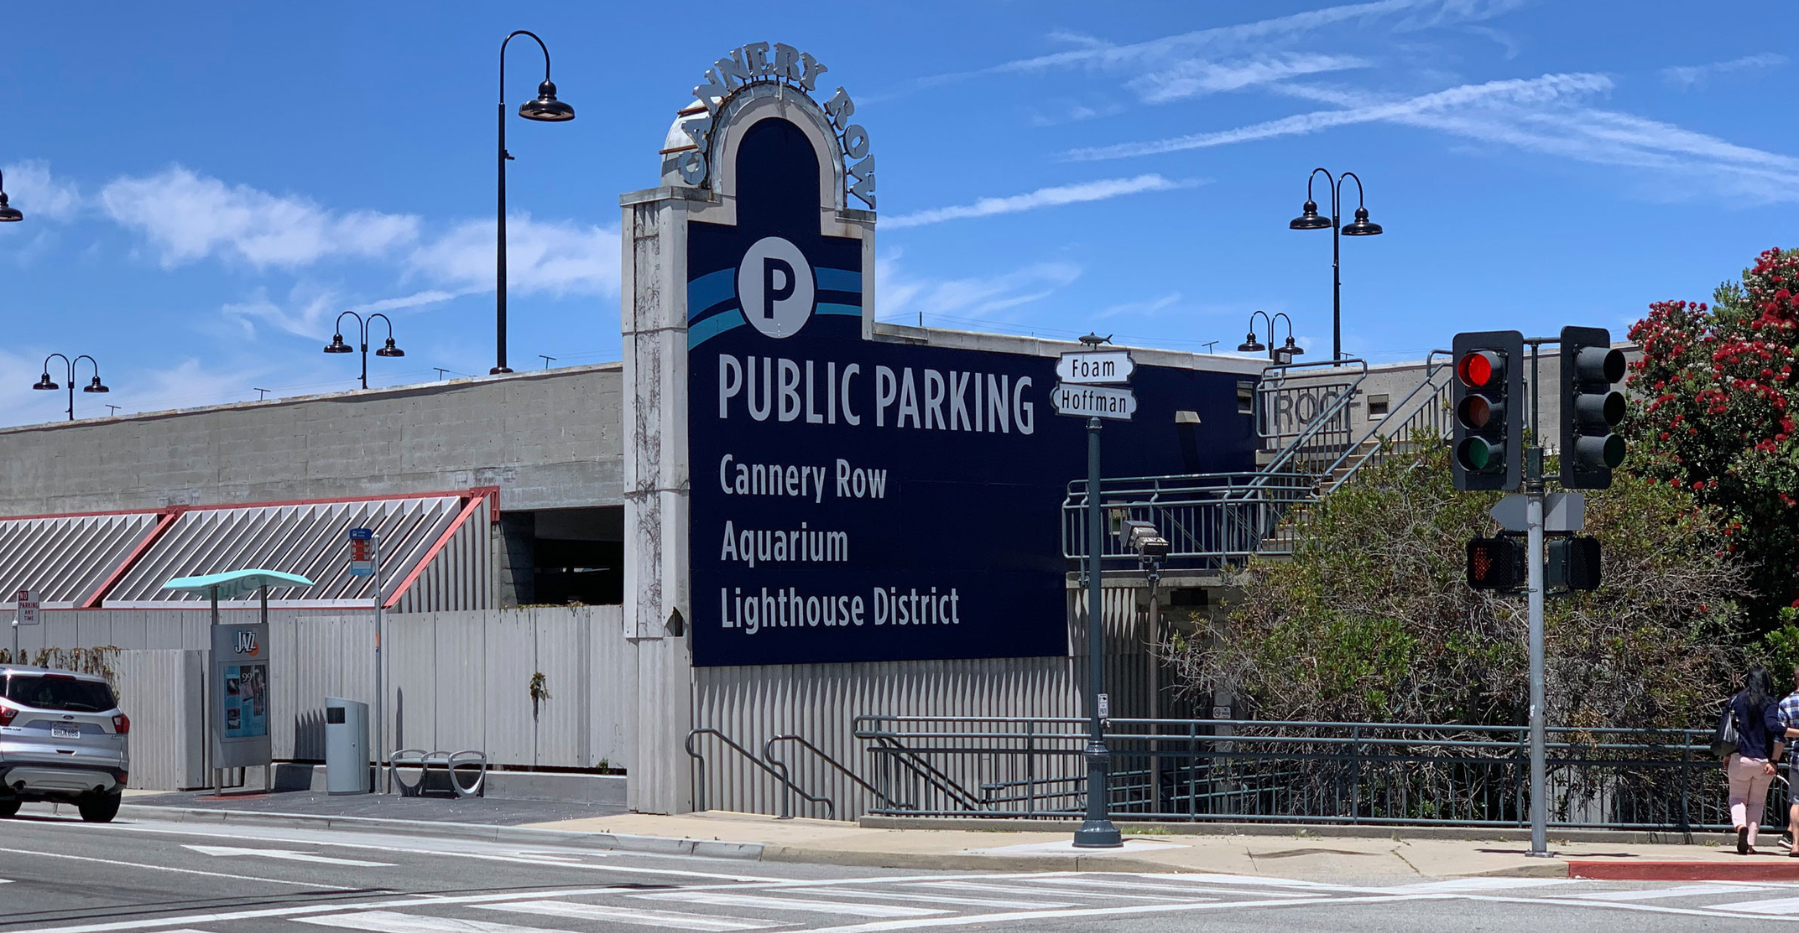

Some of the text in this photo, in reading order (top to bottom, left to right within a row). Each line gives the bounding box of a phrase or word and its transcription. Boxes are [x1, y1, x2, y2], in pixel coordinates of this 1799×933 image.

[678, 41, 877, 209] CANNERY ROW
[763, 257, 796, 319] P
[1072, 359, 1114, 377] Foam
[719, 353, 1034, 435] PUBLIC PARKING
[1062, 390, 1126, 413] Hoffman
[720, 453, 887, 503] Cannery Row
[721, 520, 848, 568] Aquarium
[19, 591, 28, 600] NO
[721, 587, 960, 634] Lighthouse District
[235, 631, 257, 653] JAZZ
